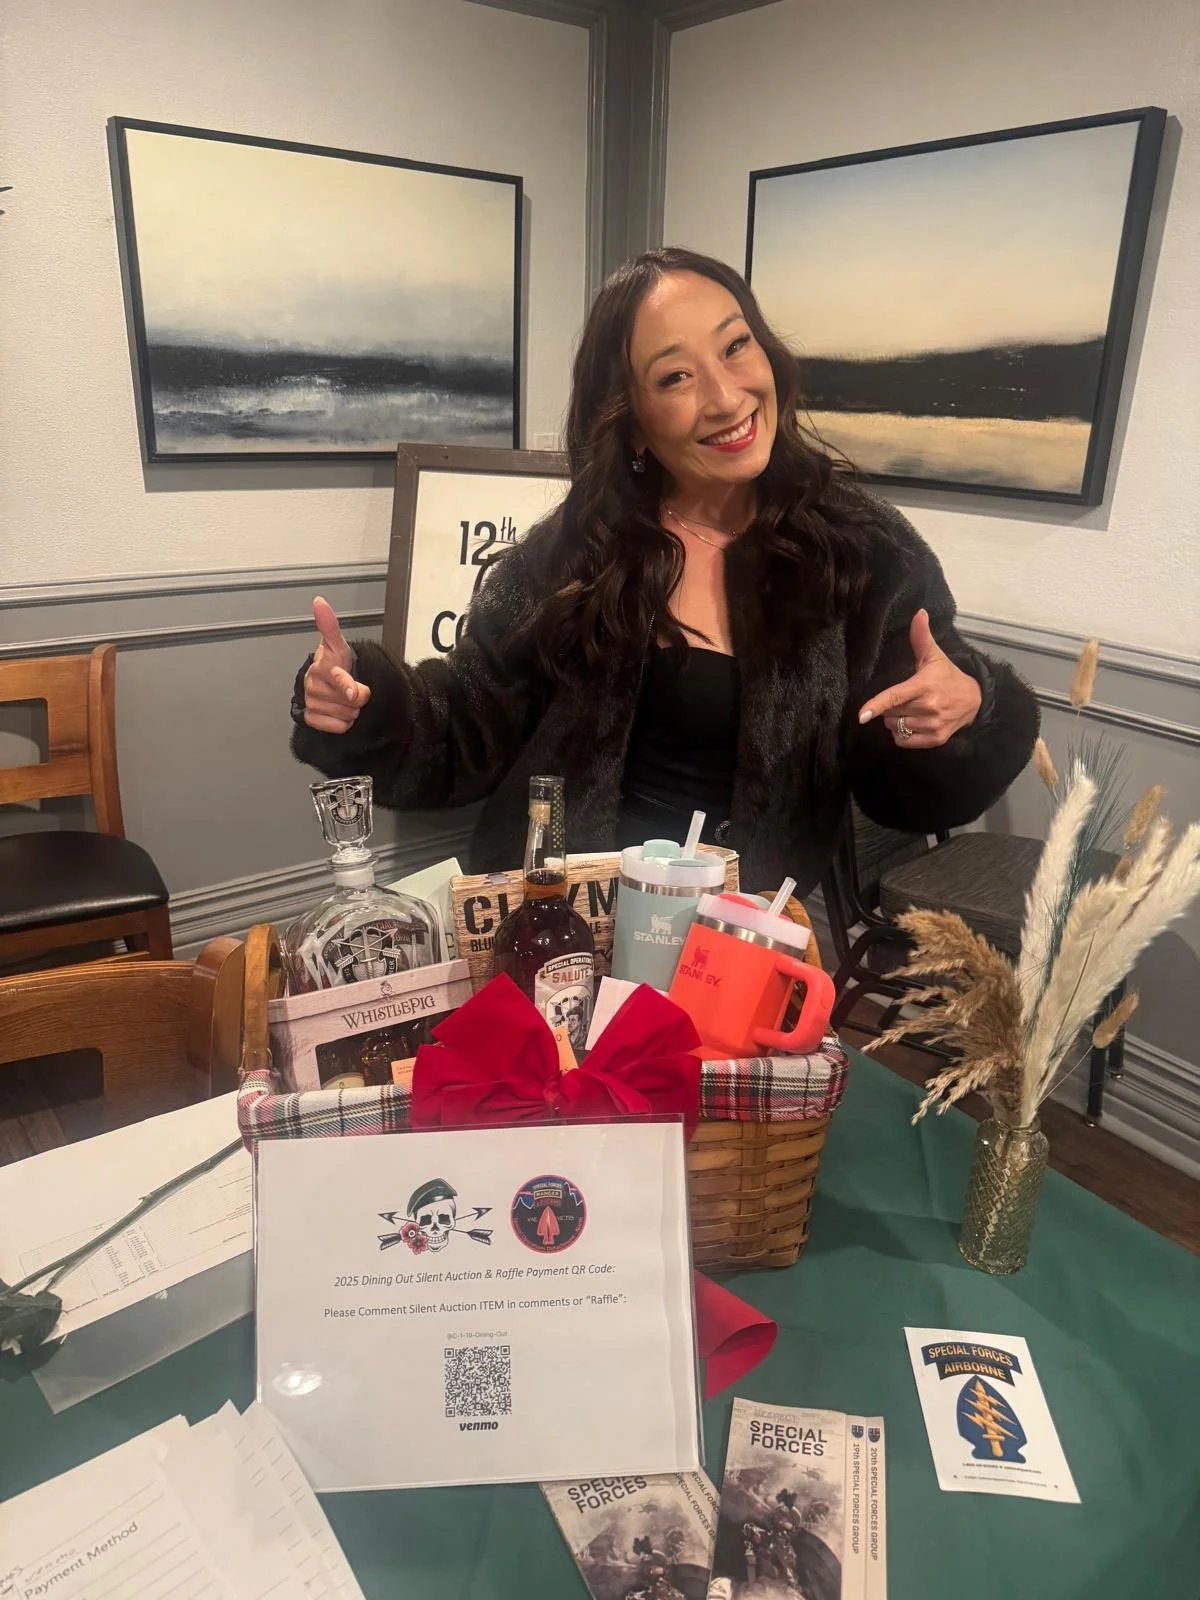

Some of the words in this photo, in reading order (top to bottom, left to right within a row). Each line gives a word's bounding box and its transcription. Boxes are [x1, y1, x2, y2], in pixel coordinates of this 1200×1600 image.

[548, 960, 569, 972] SPECIAL
[552, 968, 589, 983] SALUTE
[334, 1276, 358, 1287] 2025
[361, 1275, 393, 1286] Dining
[395, 1273, 413, 1284] Out
[415, 1272, 443, 1283] Silent
[445, 1270, 482, 1281] Auction
[484, 1269, 493, 1279] &
[496, 1268, 524, 1279] Raffle
[526, 1266, 569, 1278] Payment
[571, 1265, 586, 1275] QR
[588, 1264, 616, 1274] Code:
[324, 1308, 356, 1318] Please
[358, 1305, 407, 1316] Comment
[409, 1304, 438, 1314] Silent
[439, 1302, 477, 1312] Auction
[479, 1300, 504, 1310] ITEM
[507, 1299, 516, 1309] in
[519, 1297, 571, 1308] comments
[573, 1298, 584, 1306] or
[928, 1345, 971, 1360] SPECIAL
[971, 1346, 1013, 1366] FORCES
[944, 1361, 1006, 1380] AIRBORNE
[459, 1421, 499, 1431] venmo
[750, 1420, 828, 1443] SPECIAL
[750, 1433, 824, 1456] FORCES
[852, 1461, 860, 1492] SPECIAL
[870, 1466, 878, 1497] SPECIAL
[575, 1475, 648, 1514] FORCES
[691, 1500, 711, 1530] FORCES
[852, 1493, 860, 1524] FORCES
[870, 1499, 878, 1531] FORCES
[851, 1525, 859, 1555] GROUP
[870, 1532, 878, 1561] GROUP
[24, 1558, 86, 1600] Payment
[86, 1521, 138, 1561] Method
